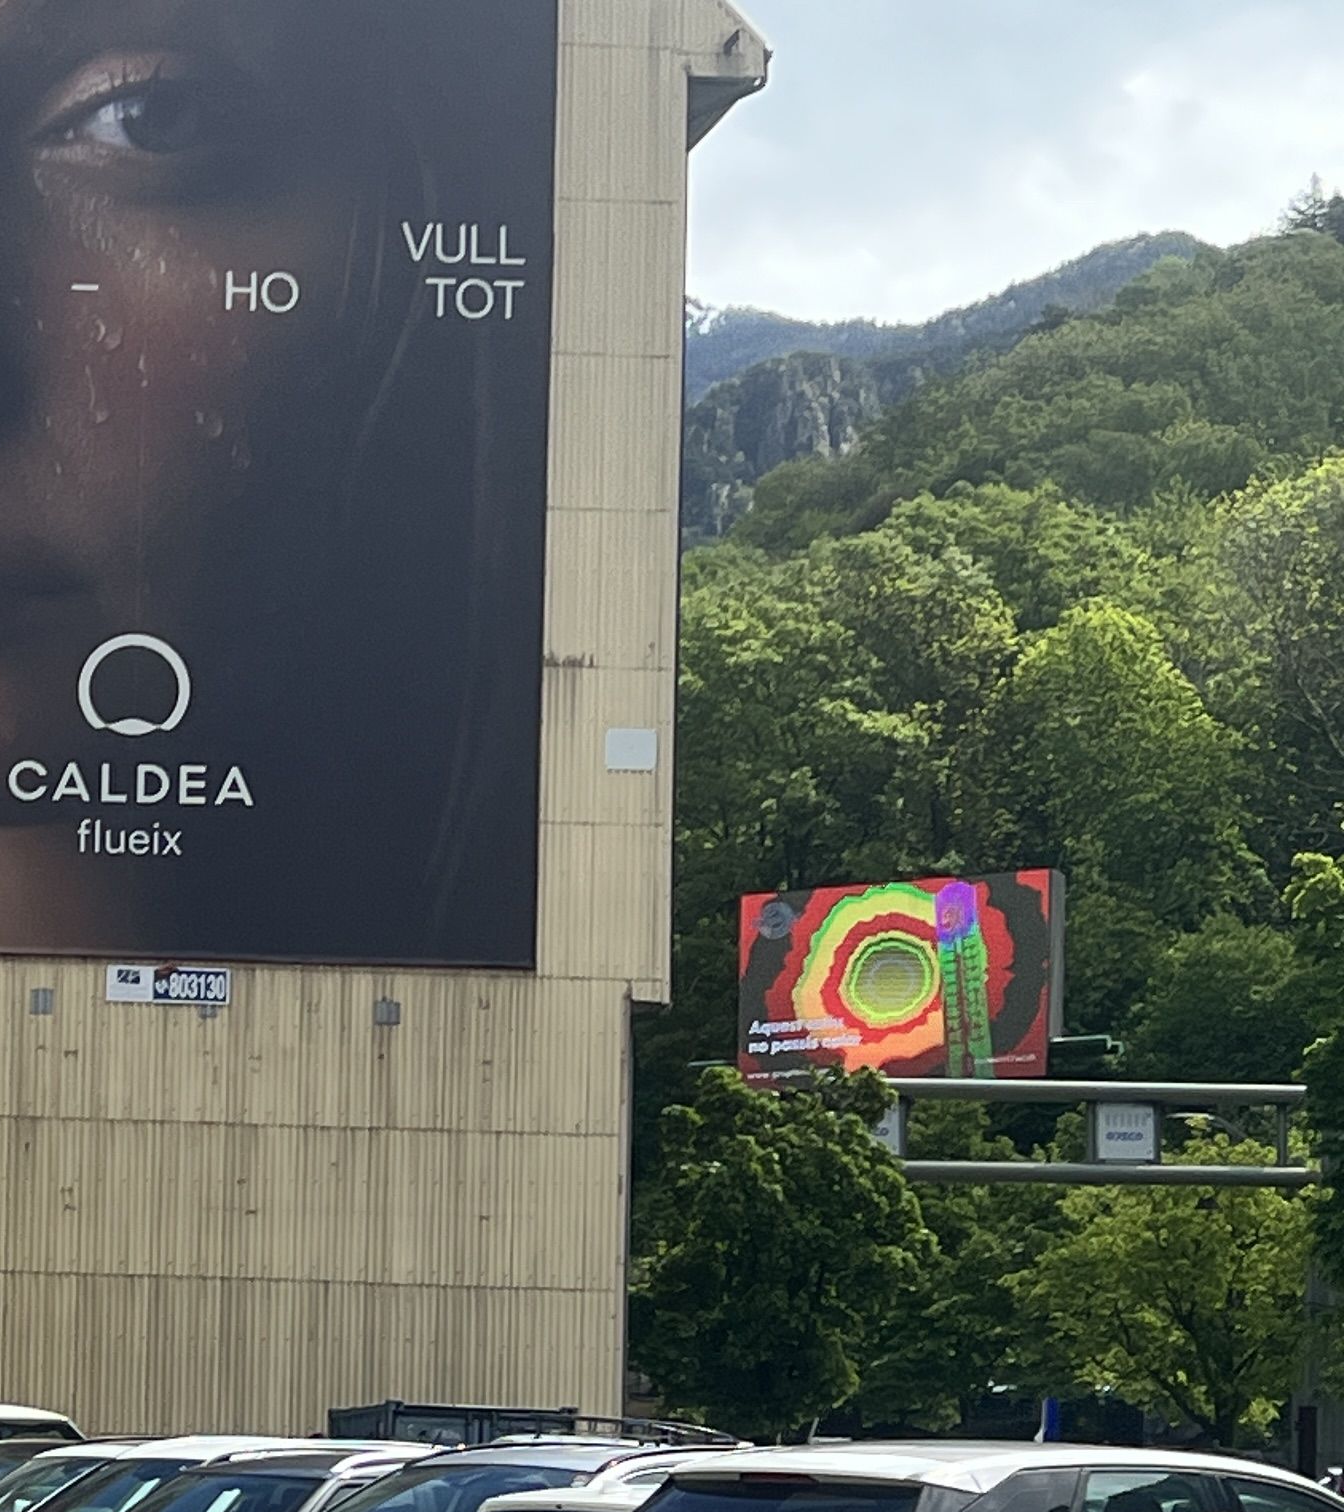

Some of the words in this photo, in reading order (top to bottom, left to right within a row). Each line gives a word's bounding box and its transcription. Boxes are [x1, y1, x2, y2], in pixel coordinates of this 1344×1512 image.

[402, 221, 526, 265] VULL
[225, 270, 299, 313] HO
[425, 277, 525, 320] TOT
[8, 760, 253, 806] CALDEA
[77, 818, 182, 856] flueix
[168, 972, 226, 1000] 803130
